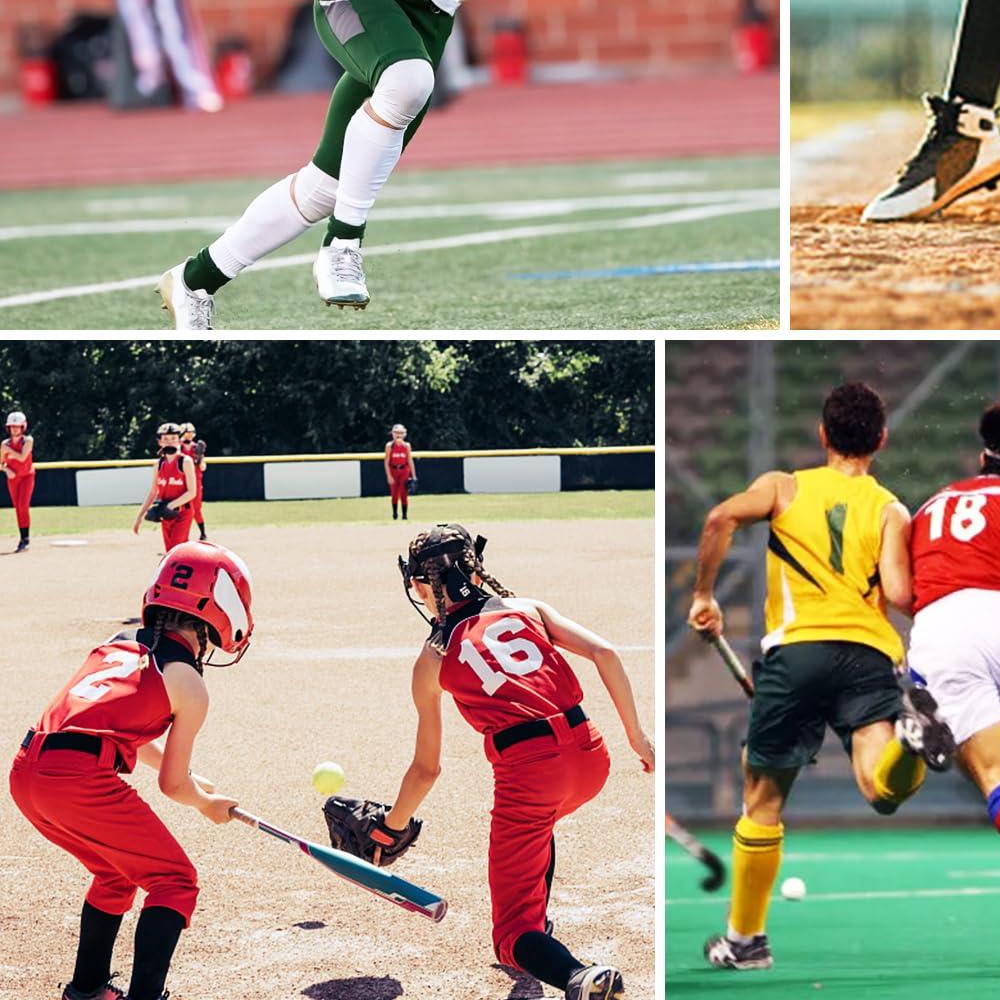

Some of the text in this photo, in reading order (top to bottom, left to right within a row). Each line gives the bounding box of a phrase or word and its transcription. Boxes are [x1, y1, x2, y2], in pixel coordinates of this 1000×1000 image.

[924, 494, 987, 542] 18
[170, 564, 193, 590] 2
[69, 651, 141, 700] 2
[458, 617, 544, 696] 16
